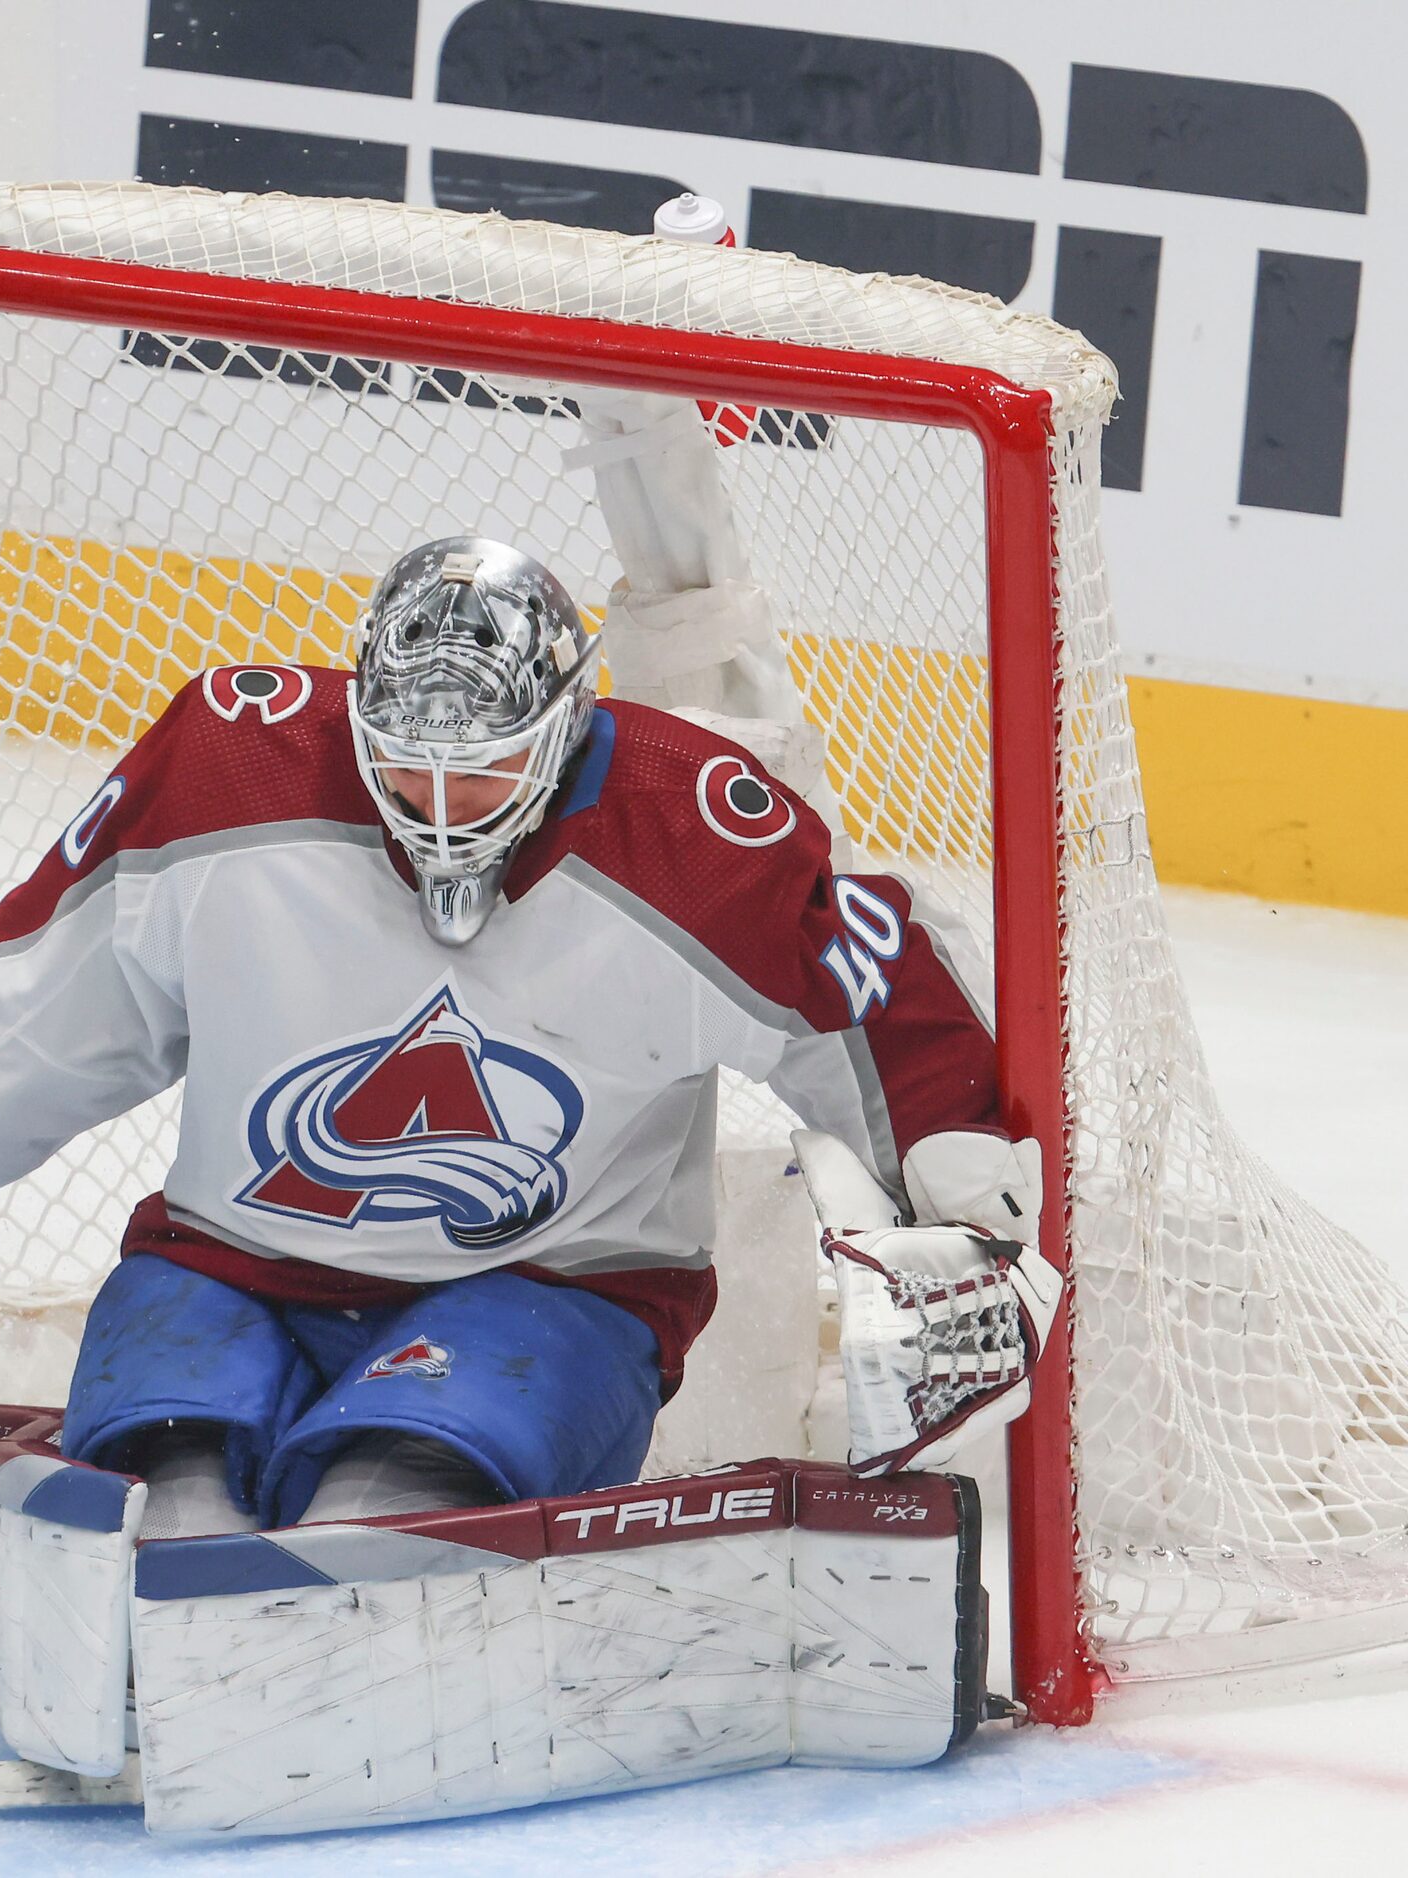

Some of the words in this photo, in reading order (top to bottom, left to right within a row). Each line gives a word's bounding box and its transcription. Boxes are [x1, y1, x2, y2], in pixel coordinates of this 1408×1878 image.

[123, 0, 1369, 518] ESPN
[818, 874, 904, 1026] 40
[554, 1486, 776, 1540] TRUE
[812, 1490, 922, 1504] CATALYST
[872, 1504, 928, 1522] PX3
